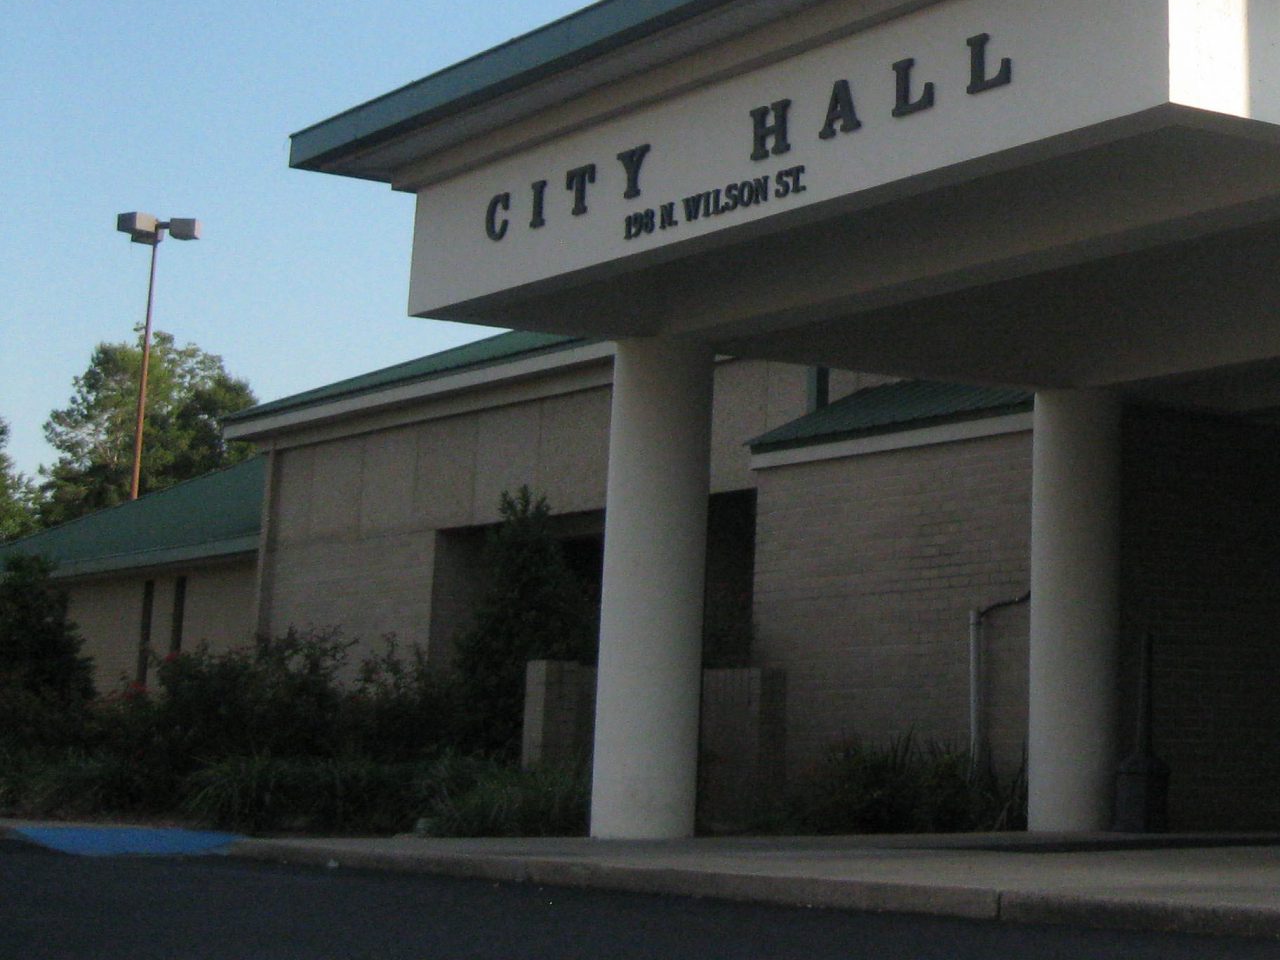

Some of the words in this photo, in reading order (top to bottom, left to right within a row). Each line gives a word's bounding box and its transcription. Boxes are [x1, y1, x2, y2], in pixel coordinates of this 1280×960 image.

[485, 144, 651, 241] CITY
[748, 33, 1011, 160] HALL
[624, 208, 655, 239] 198
[660, 202, 678, 229] N.
[683, 176, 770, 221] WILSON
[775, 165, 806, 198] ST.
